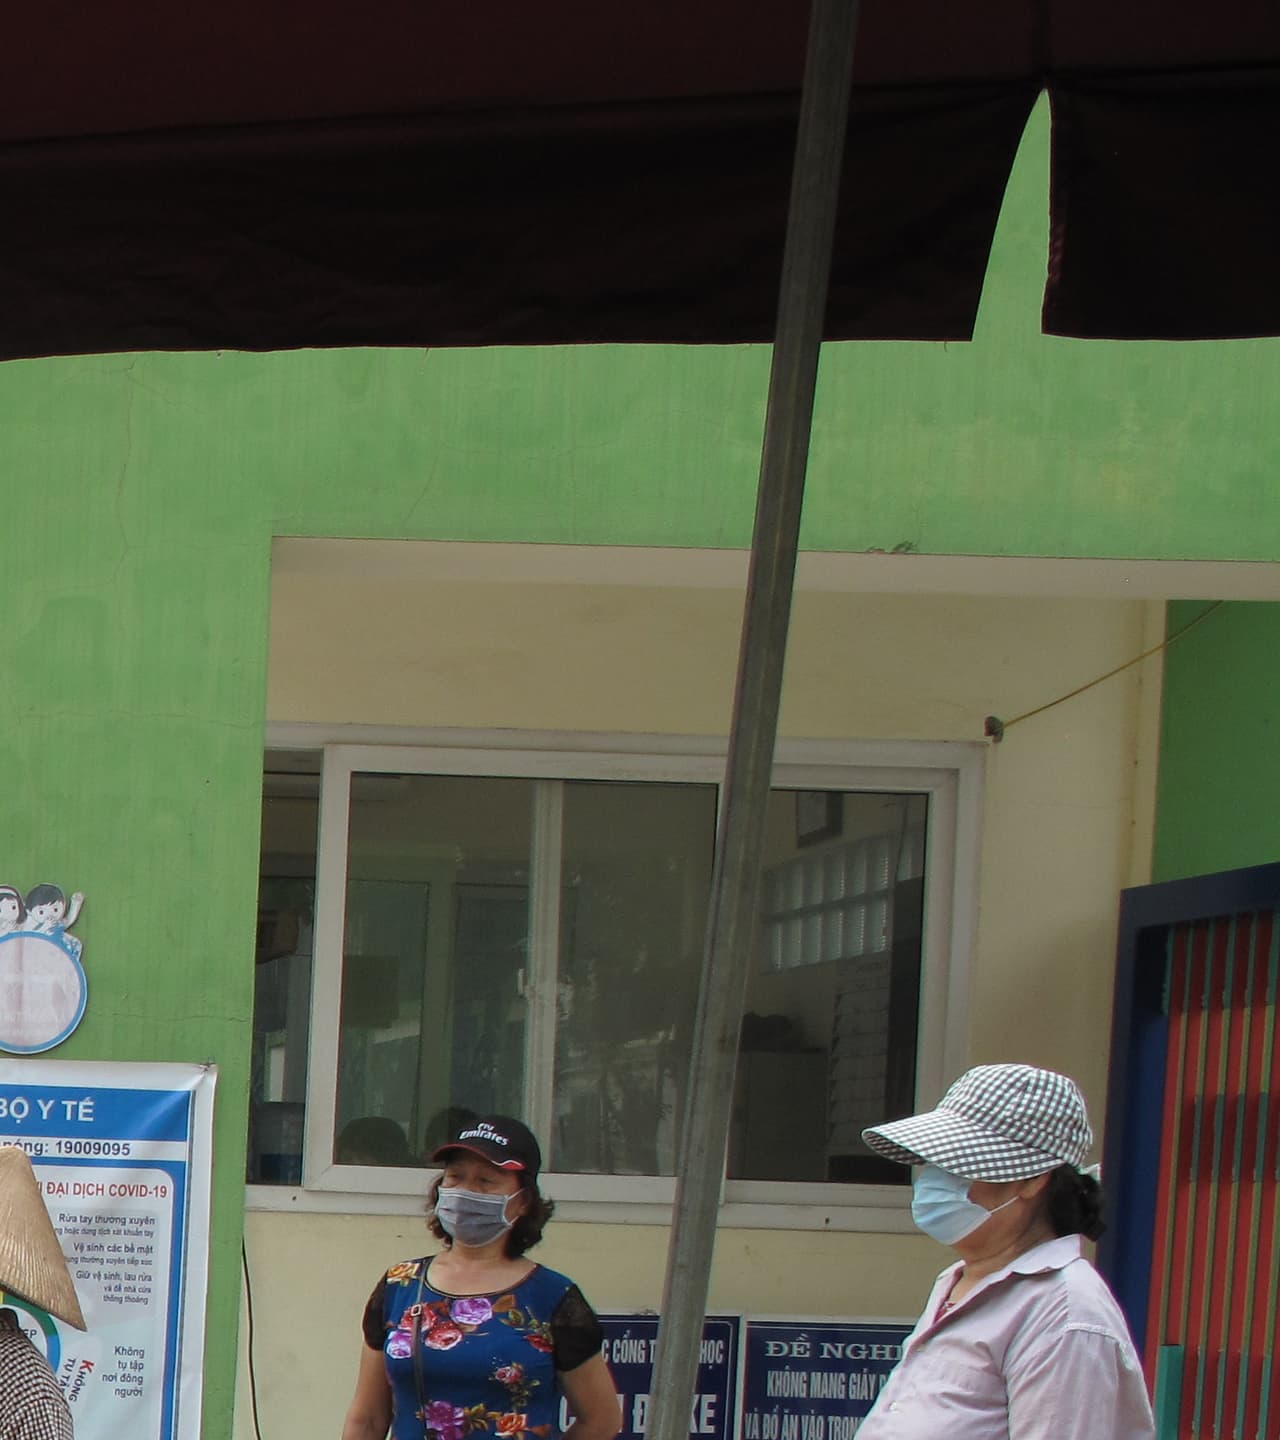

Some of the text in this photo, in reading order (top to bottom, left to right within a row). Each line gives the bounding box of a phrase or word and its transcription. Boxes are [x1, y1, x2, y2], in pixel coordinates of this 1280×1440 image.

[37, 1099, 55, 1120] Y
[62, 1096, 95, 1122] TẾ
[459, 1129, 510, 1147] Emirates
[55, 1139, 131, 1157] 19009095
[46, 1181, 69, 1199] ĐẠI
[72, 1182, 105, 1200] DỊCH
[108, 1182, 168, 1199] COVID-19
[114, 1345, 145, 1359] Không
[765, 1333, 811, 1358] ĐỀ
[118, 1360, 144, 1372] tụ tập
[68, 1359, 95, 1402] KHÔNG
[102, 1373, 144, 1385] nơi đông
[766, 1365, 807, 1398] KHÔNG
[810, 1371, 846, 1399] MANG
[114, 1387, 143, 1398] người
